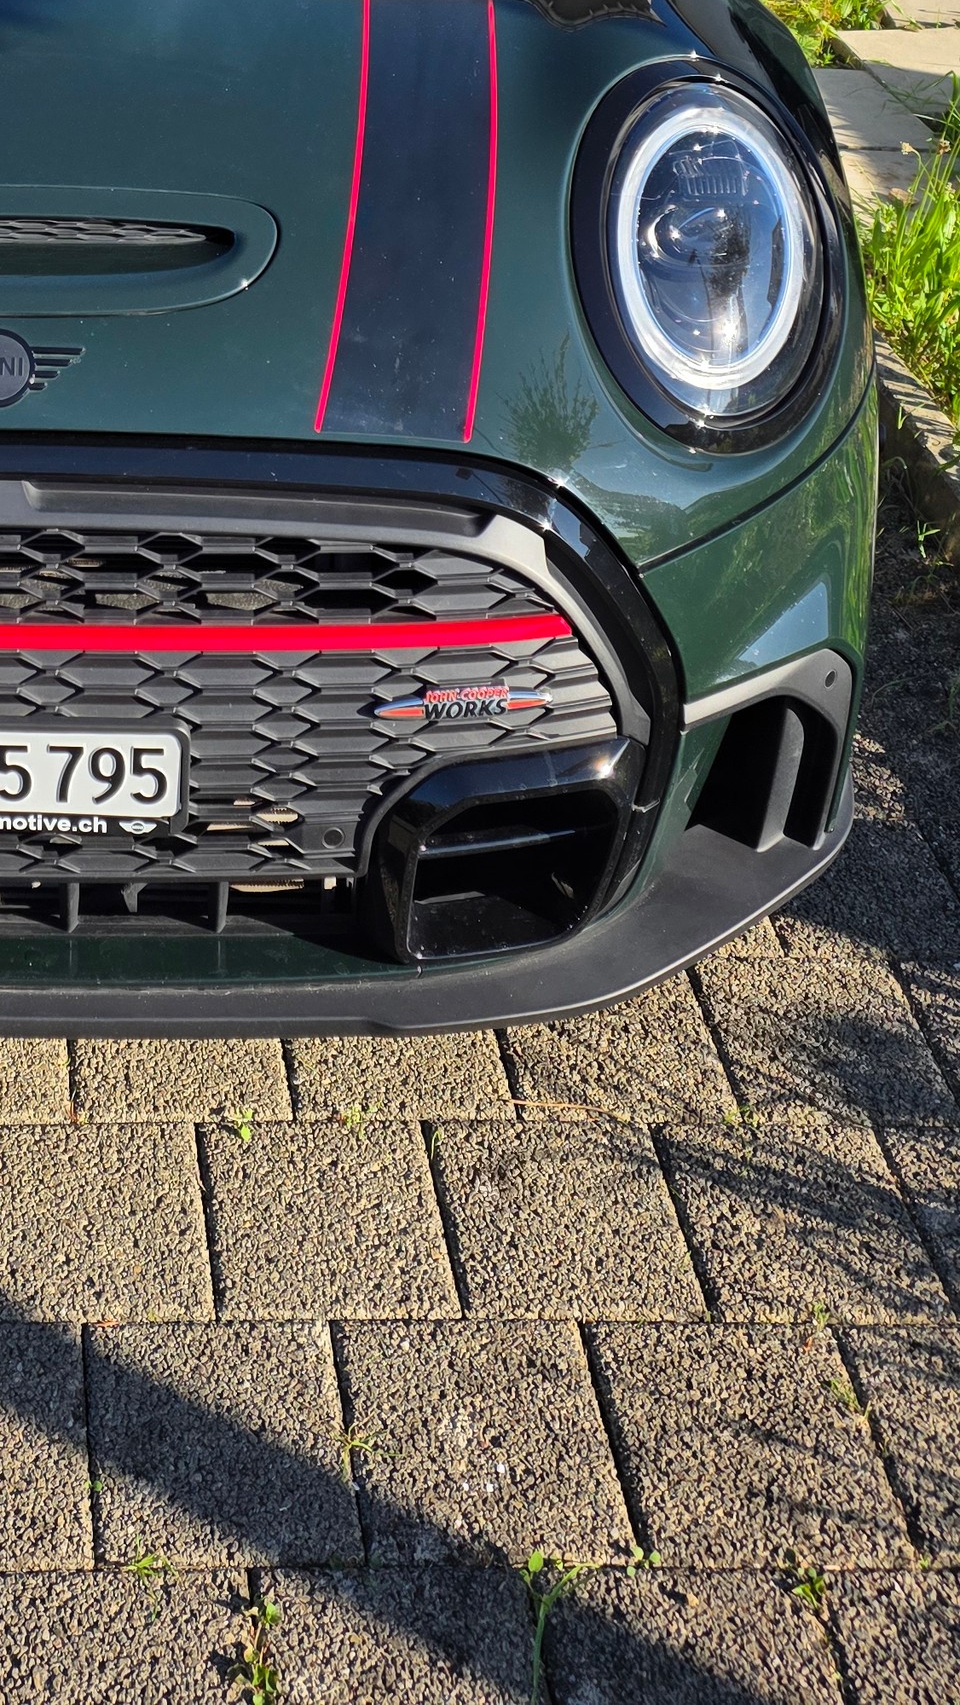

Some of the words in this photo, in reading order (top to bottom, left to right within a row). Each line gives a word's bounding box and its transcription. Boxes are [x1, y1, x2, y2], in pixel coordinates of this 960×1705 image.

[425, 689, 458, 703] JOHN
[460, 686, 508, 700] COOPER
[424, 698, 508, 719] WORKS
